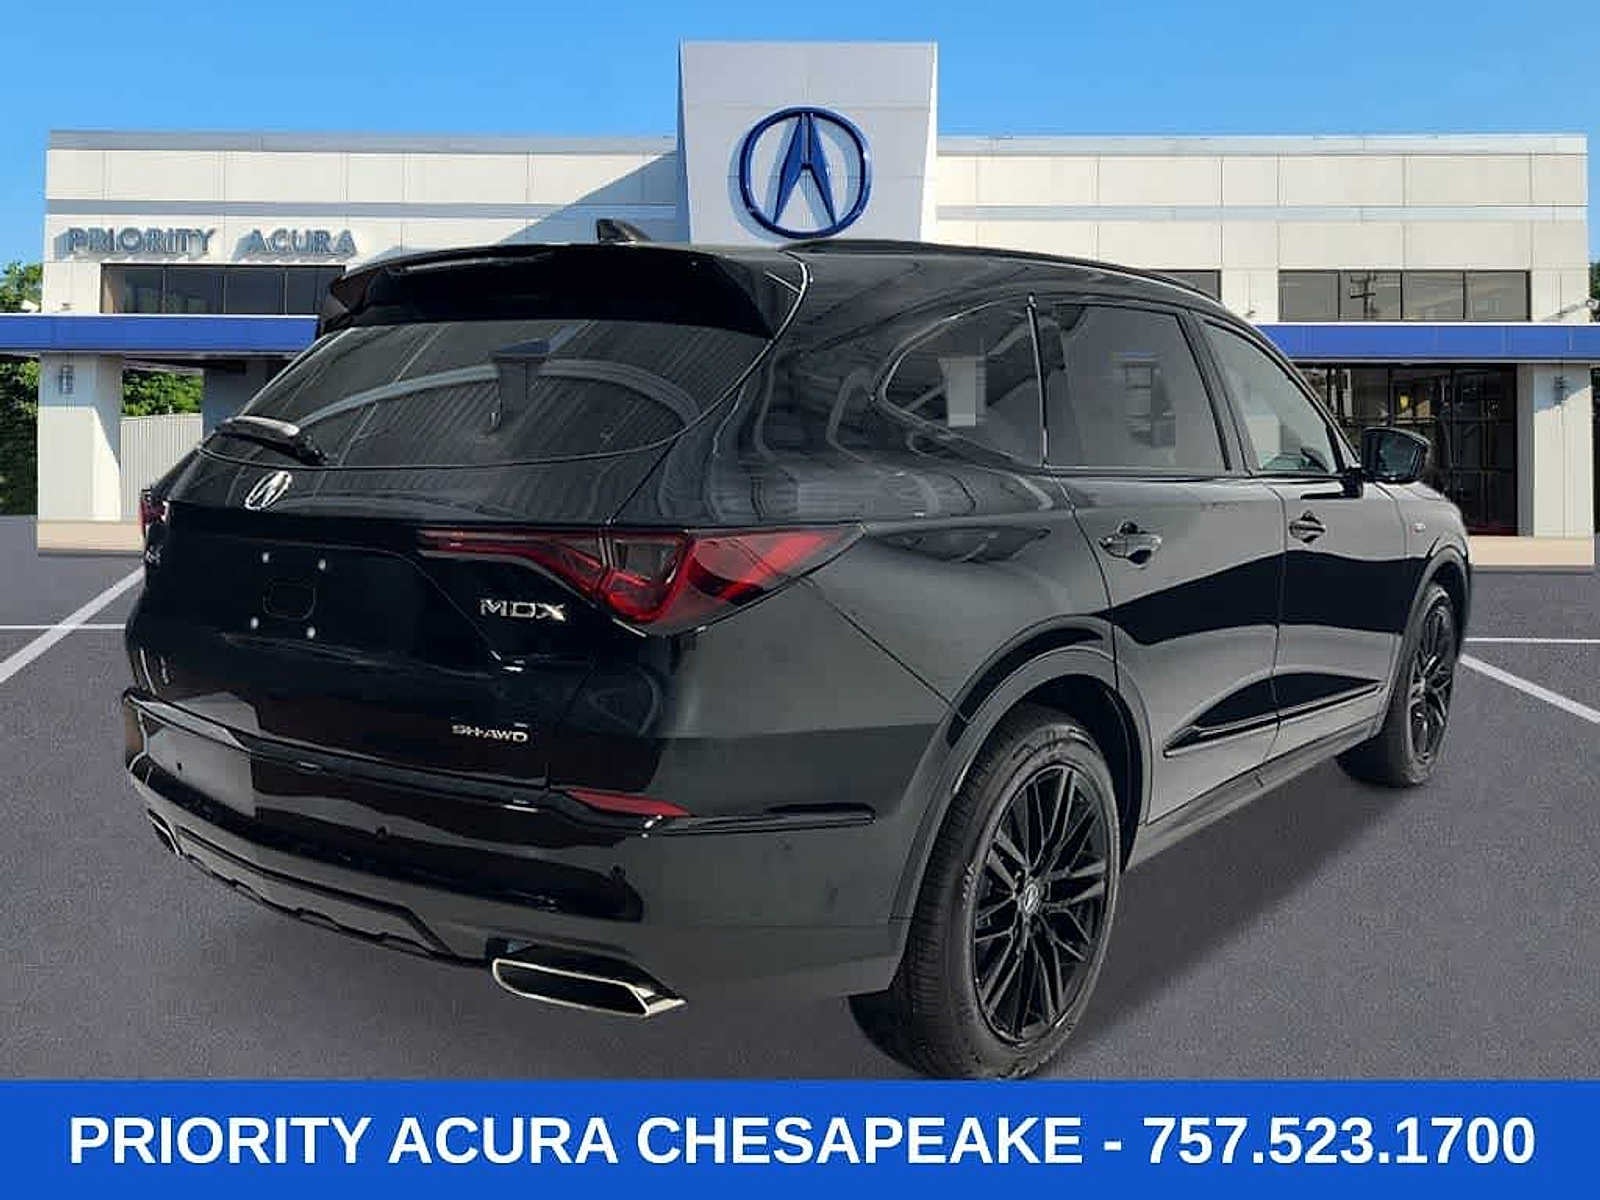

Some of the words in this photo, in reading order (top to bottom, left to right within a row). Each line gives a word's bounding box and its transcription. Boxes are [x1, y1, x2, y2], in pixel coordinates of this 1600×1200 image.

[66, 227, 215, 253] PRIORITY
[248, 228, 357, 255] ACURA
[479, 599, 566, 622] MDX
[451, 724, 529, 743] SH-AWD
